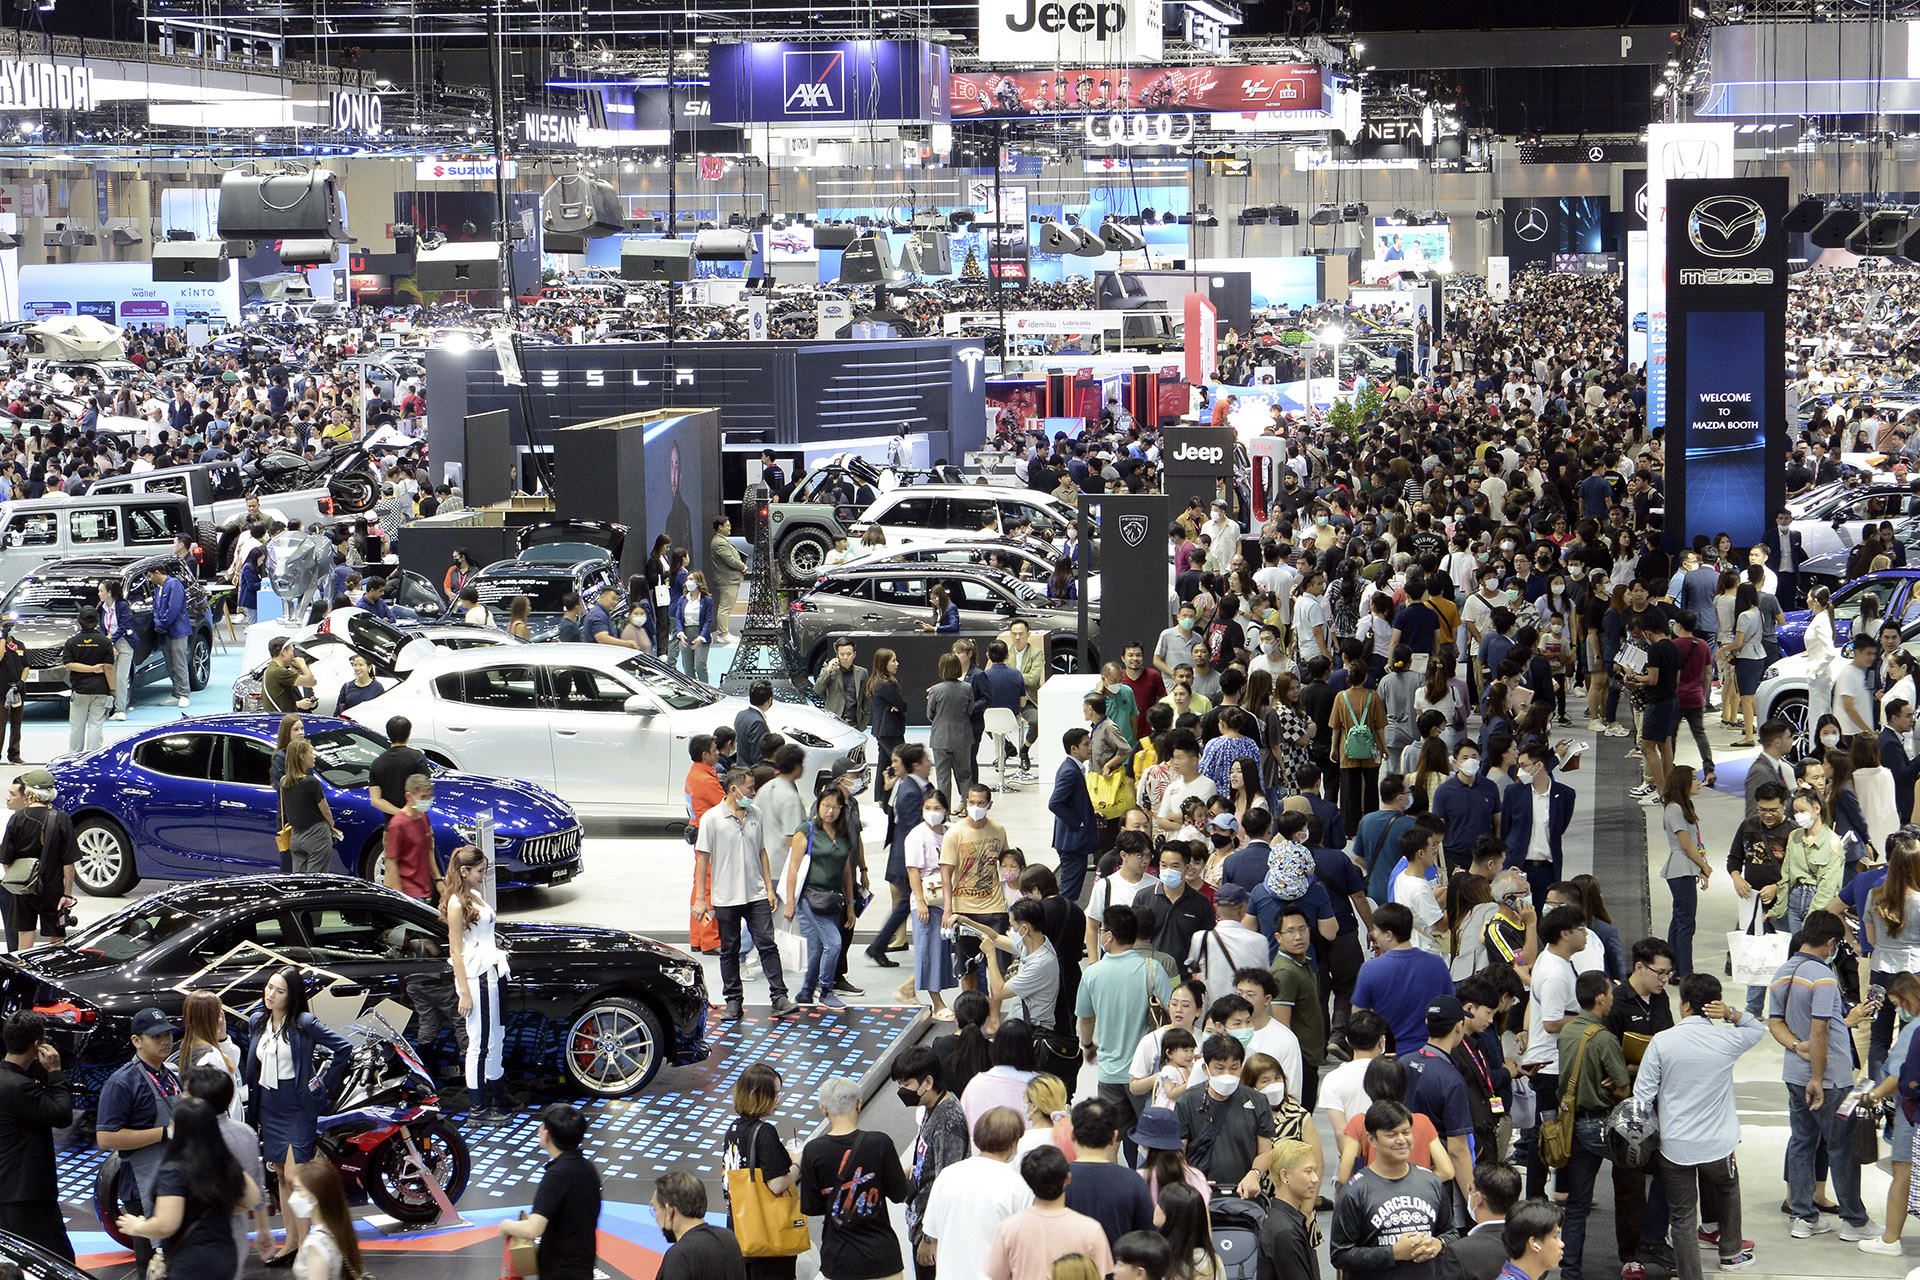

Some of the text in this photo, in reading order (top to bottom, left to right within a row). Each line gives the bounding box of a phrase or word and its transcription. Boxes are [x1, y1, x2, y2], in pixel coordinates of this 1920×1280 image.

[1006, 0, 1126, 41] Jeep
[1620, 36, 1632, 57] P
[786, 83, 834, 107] AXA
[950, 80, 977, 100] EO
[332, 91, 382, 133] IONIQ
[525, 112, 577, 143] NISSAN
[1368, 122, 1422, 139] NETA
[448, 165, 495, 175] SUZUK
[132, 290, 156, 298] wallet
[1028, 320, 1057, 328] idemitsu
[1699, 393, 1751, 402] WELCOME
[1719, 407, 1730, 416] TO
[1692, 421, 1759, 430] MAZDA BOOTH
[1173, 442, 1224, 464] Jeep
[1370, 1195, 1437, 1230] BARCELONA
